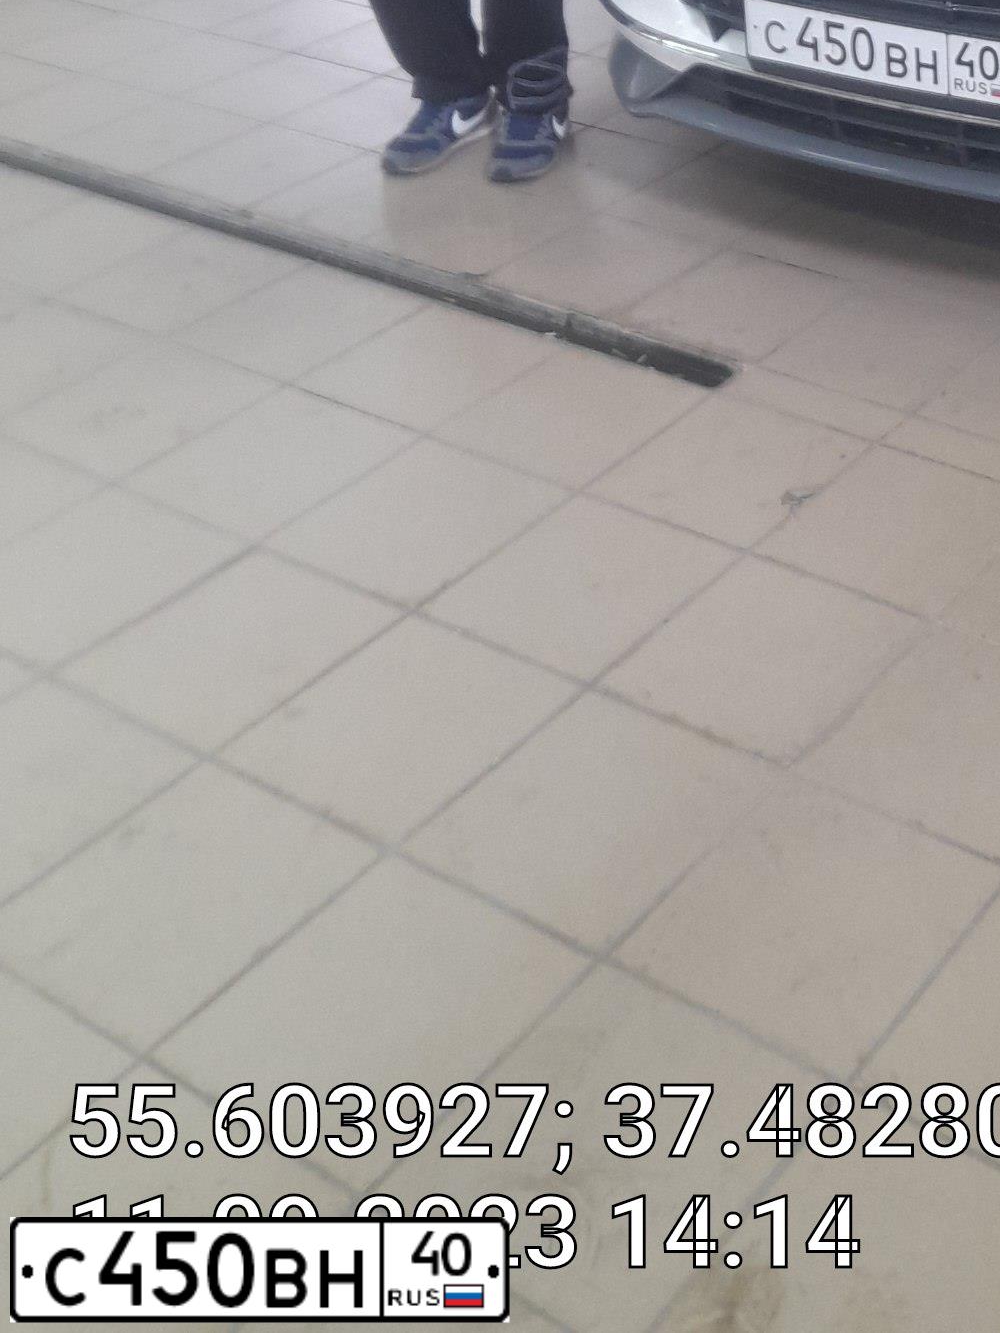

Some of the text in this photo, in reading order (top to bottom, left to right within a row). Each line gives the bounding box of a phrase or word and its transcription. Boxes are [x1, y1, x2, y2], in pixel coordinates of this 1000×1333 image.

[764, 16, 1000, 85] С450ВН 40
[954, 77, 989, 96] RUS
